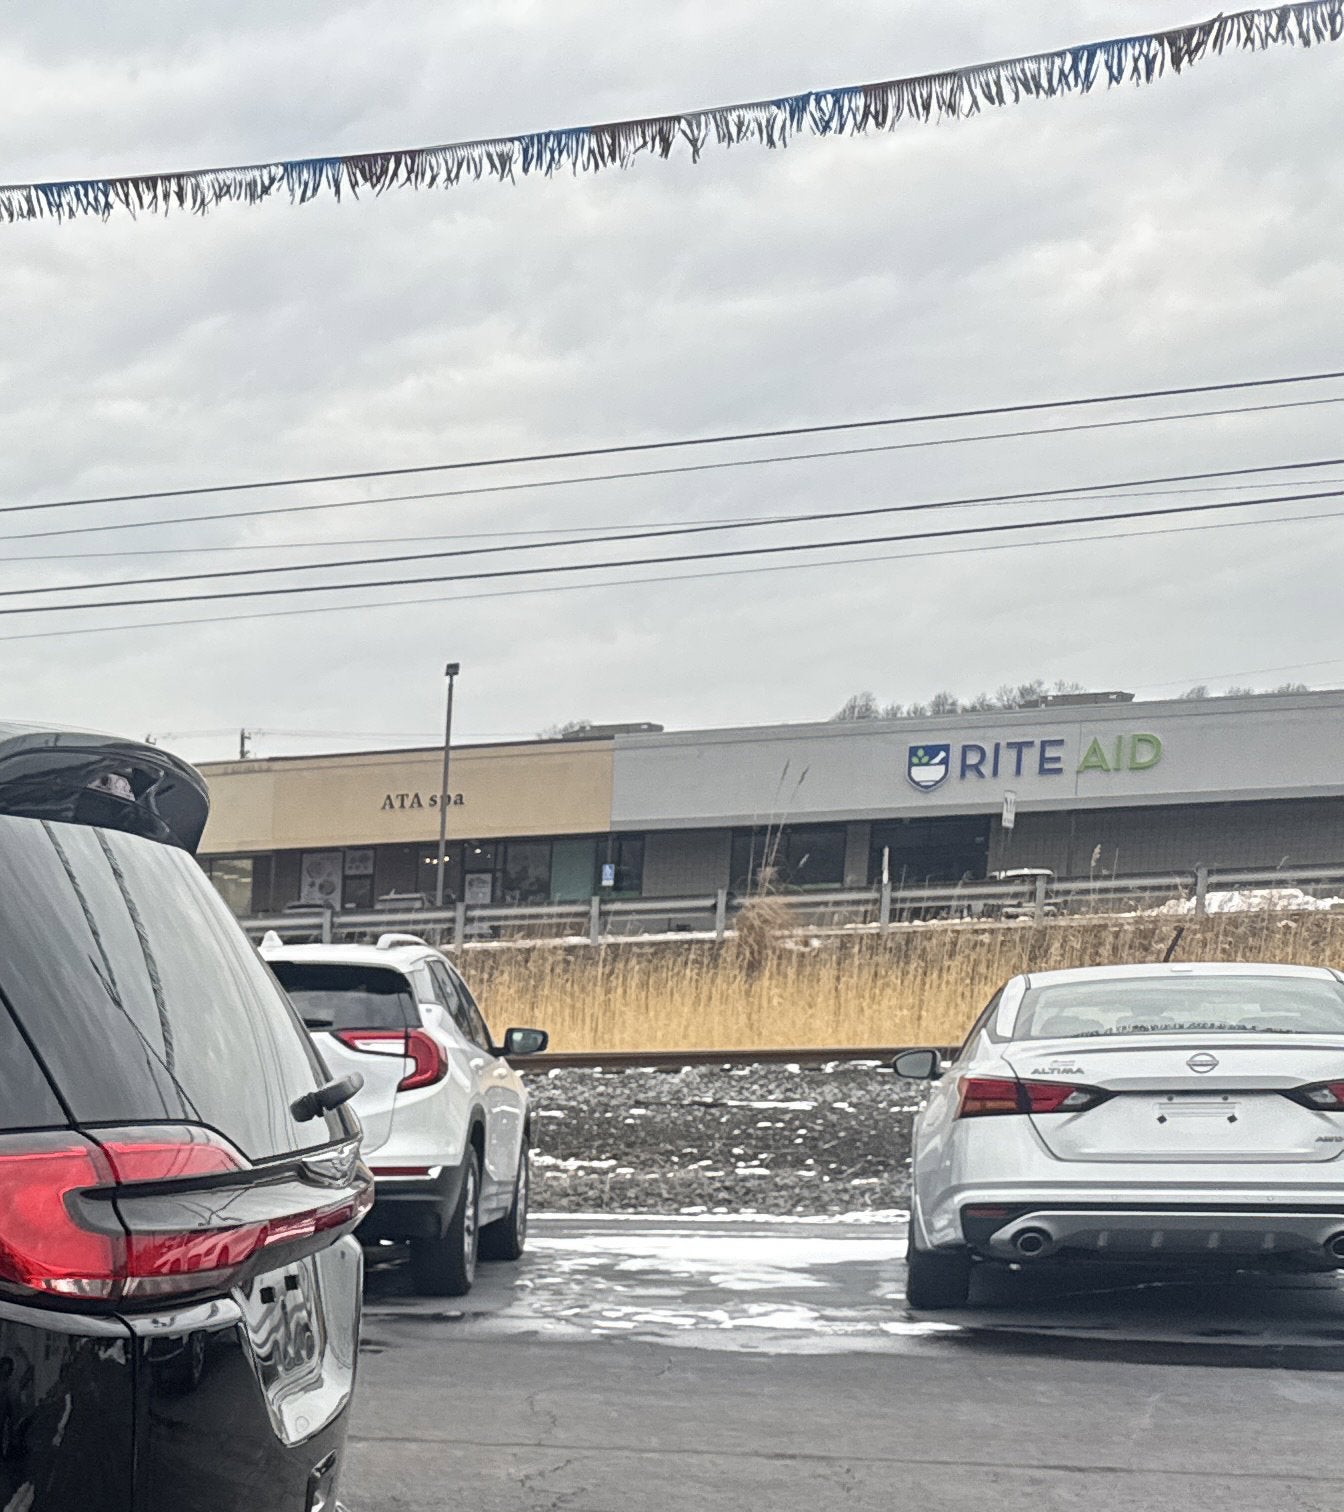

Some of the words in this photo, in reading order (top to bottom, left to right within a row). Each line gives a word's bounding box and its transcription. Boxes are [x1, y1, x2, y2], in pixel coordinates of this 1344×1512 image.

[960, 739, 1065, 780] RITE
[1076, 733, 1163, 773] AID
[381, 792, 423, 810] ATA
[428, 793, 465, 812] spa
[1031, 1067, 1085, 1075] ALTIMA
